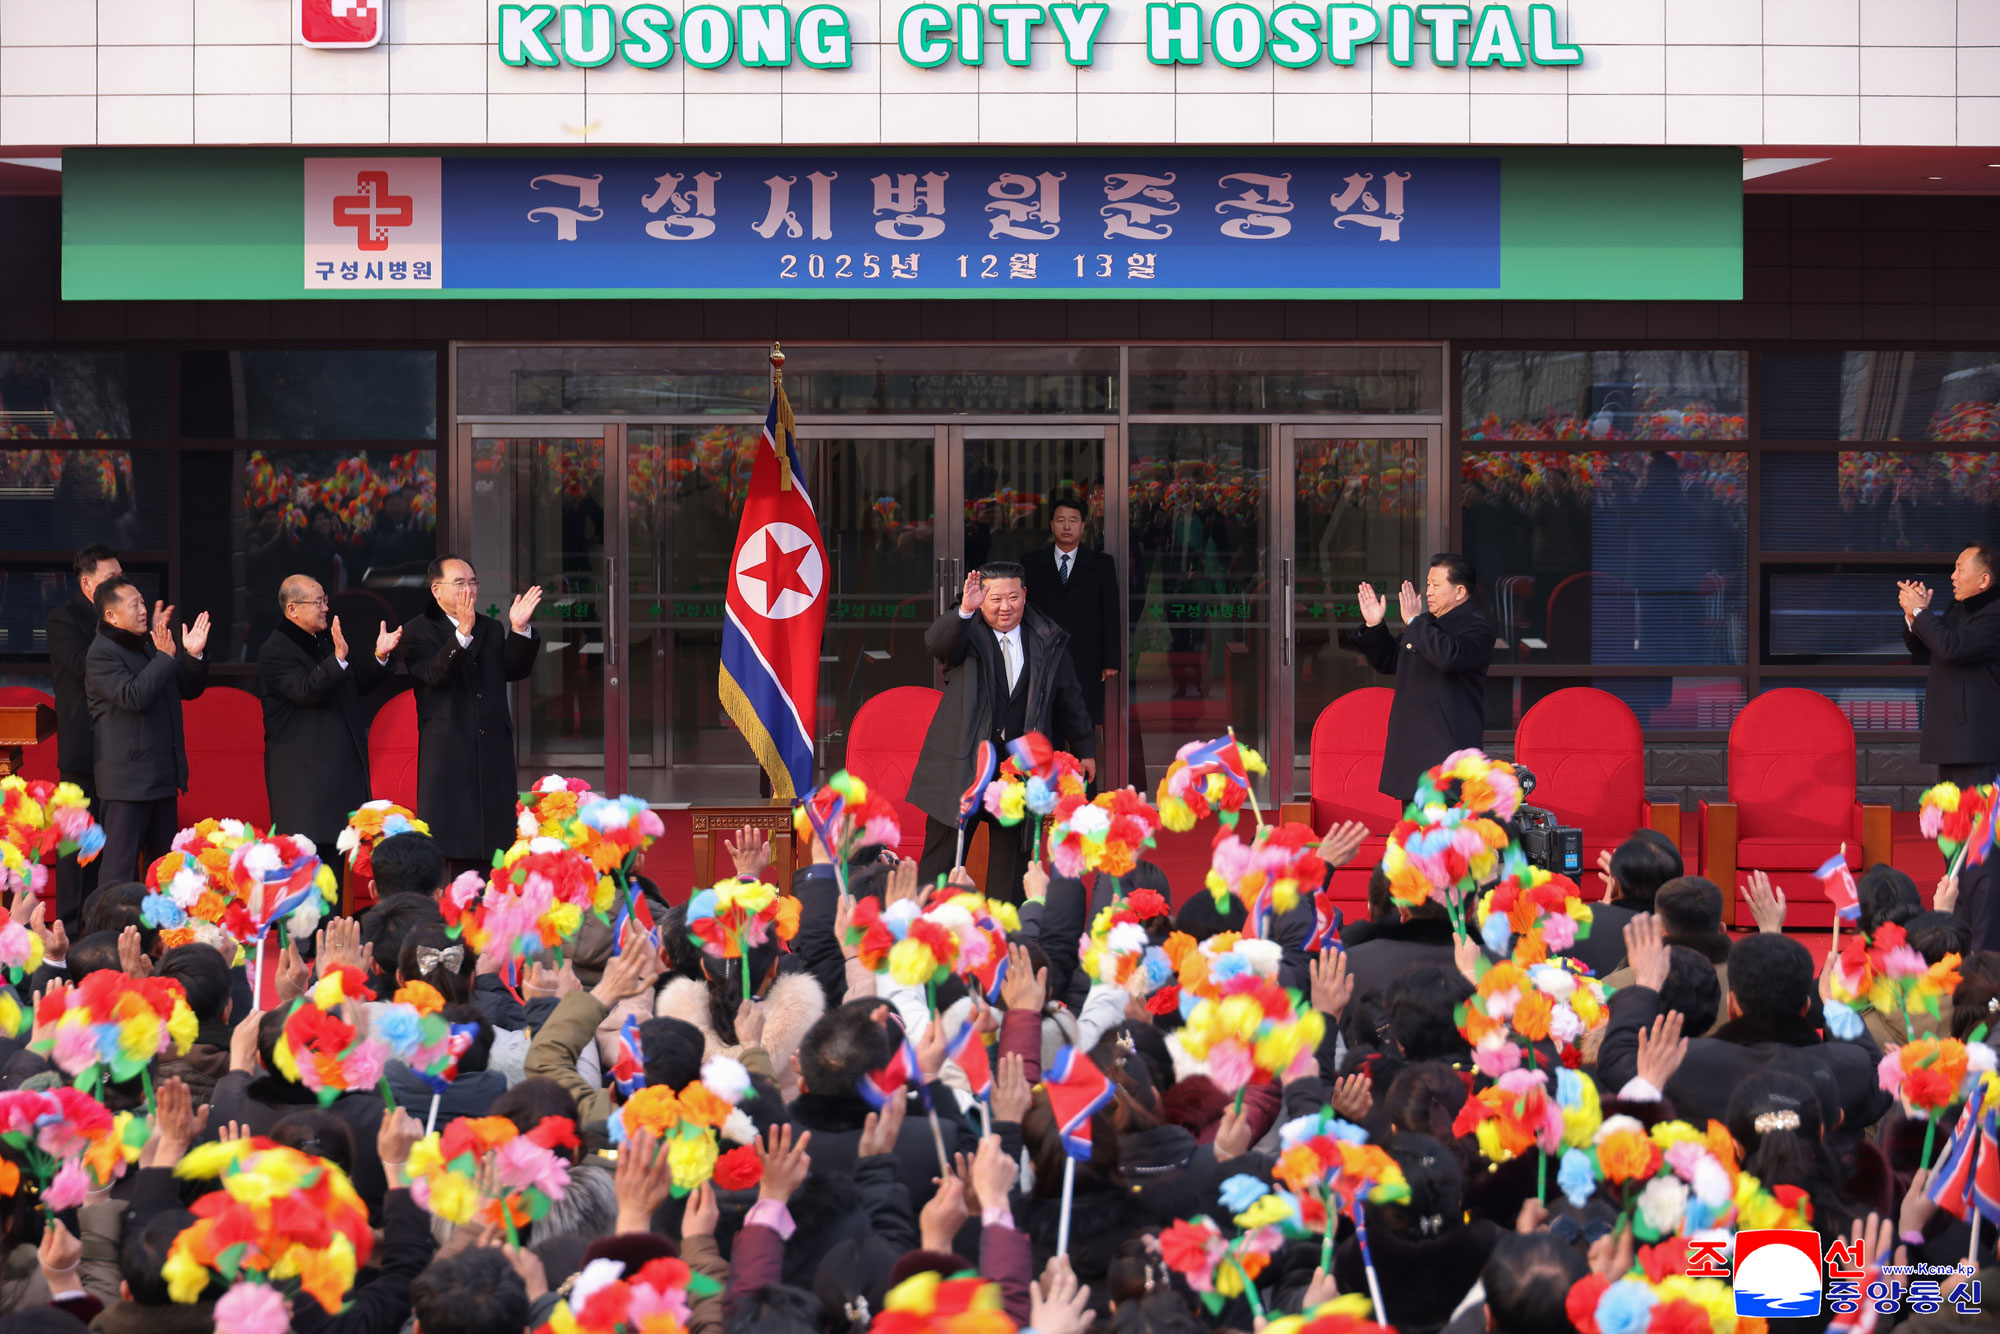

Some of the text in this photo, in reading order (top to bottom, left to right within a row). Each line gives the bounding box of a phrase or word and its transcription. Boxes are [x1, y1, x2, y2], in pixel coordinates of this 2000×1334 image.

[499, 4, 1584, 69] KUSONG CITY HOSPITAL
[527, 170, 1412, 243] 구성시병원준공식
[315, 261, 432, 281] 구성시병원
[780, 252, 1158, 280] 2025년 12월 13일
[835, 603, 916, 618] 구성시병원
[1170, 603, 1251, 618] 구성시병원
